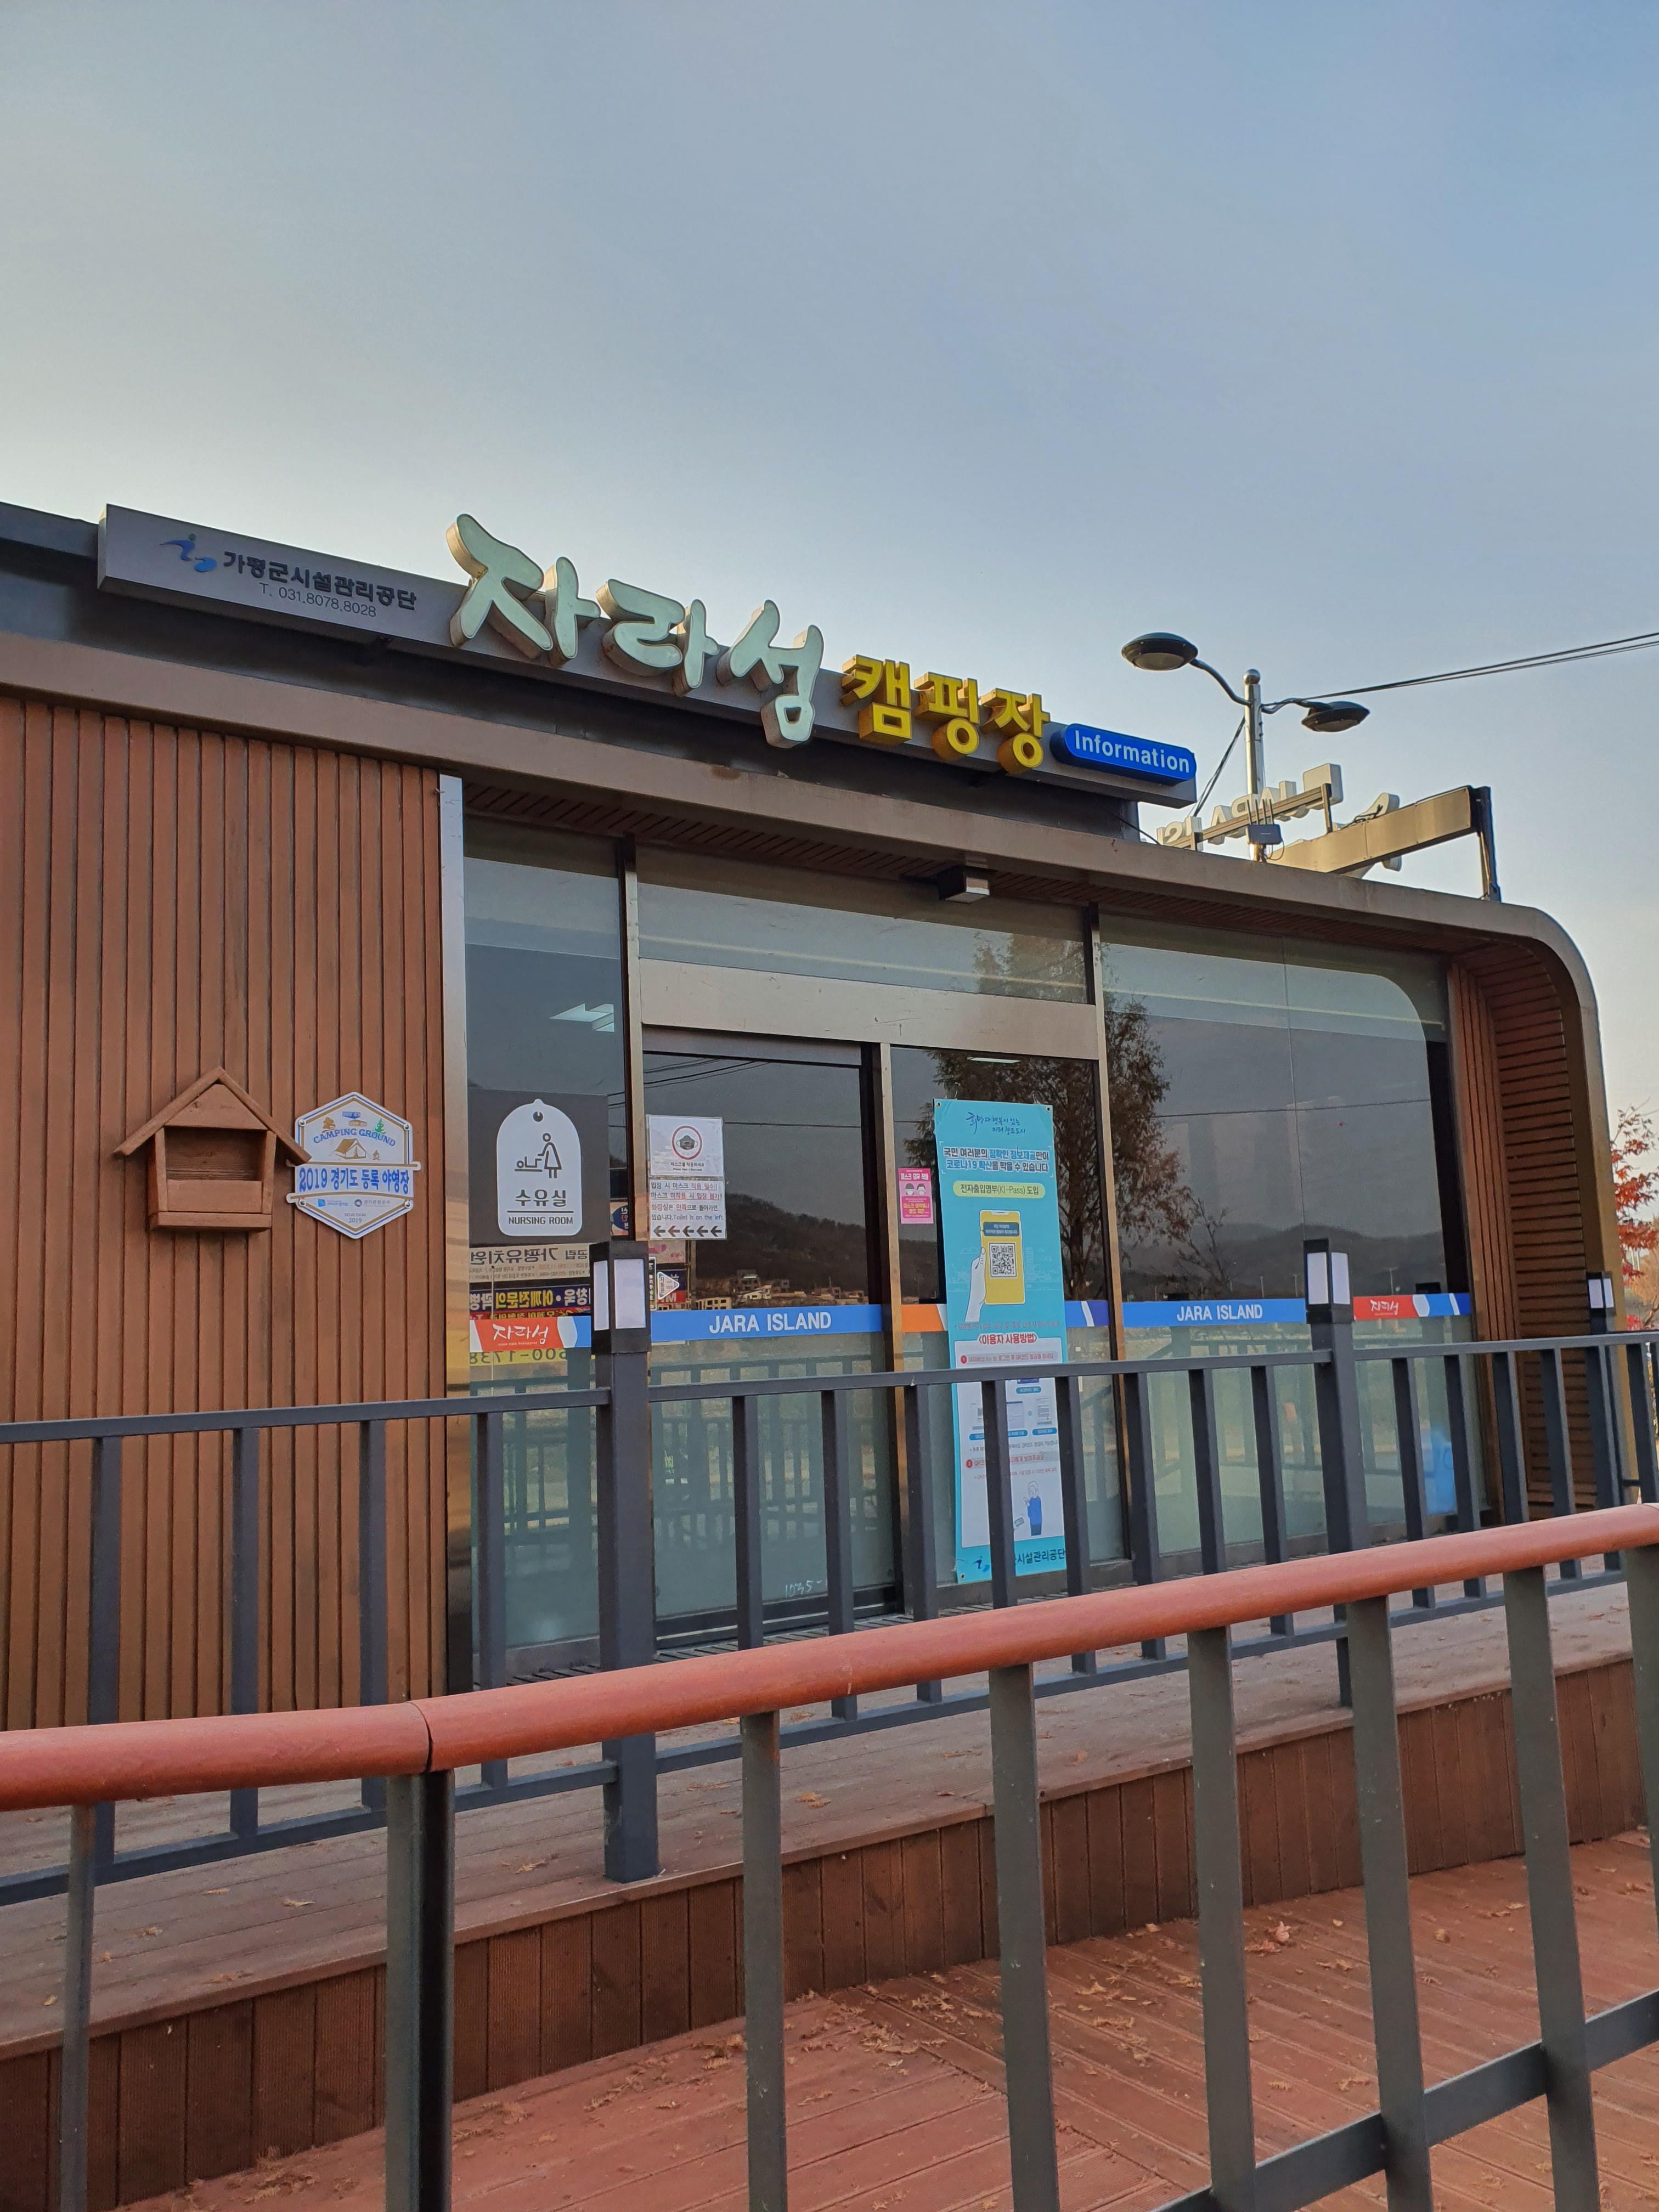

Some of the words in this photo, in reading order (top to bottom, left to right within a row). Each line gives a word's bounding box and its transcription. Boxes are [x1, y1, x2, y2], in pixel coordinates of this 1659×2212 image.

[223, 550, 417, 611] 가평군시설관리공단
[259, 582, 273, 597] T.
[278, 589, 377, 618] 031.8078.8028
[447, 514, 824, 746] 자라섬
[841, 654, 1051, 772] 캠핑장
[1074, 730, 1190, 774] Information
[313, 1128, 357, 1144] CAMPING
[359, 1128, 396, 1147] GROUND
[944, 1147, 958, 1157] 국민
[960, 1148, 988, 1158] 여러분의
[989, 1150, 1009, 1159] 정확한
[946, 1160, 977, 1170] 코로나19
[1000, 1162, 1013, 1171] 막을
[1015, 1163, 1021, 1171] 수
[1023, 1163, 1048, 1172] 있습니다
[299, 1167, 328, 1193] 2019
[331, 1167, 358, 1191] 경기도
[361, 1169, 380, 1190] 등록
[382, 1168, 410, 1194] 야영장
[961, 1183, 1025, 1195] 전자출입명부(KI-Pass)
[1027, 1186, 1039, 1195] 도입
[515, 1189, 567, 1208] 수유실
[697, 1192, 707, 1200] 입장
[508, 1216, 546, 1224] NURSING
[549, 1216, 573, 1224] ROOM
[1176, 1306, 1211, 1322] JARA
[1216, 1304, 1263, 1320] ISLAND
[709, 1314, 760, 1334] JARA
[768, 1312, 832, 1331] ISLAND
[492, 1323, 549, 1345] 자라섬
[1014, 1548, 1065, 1565] 시설관리공단
